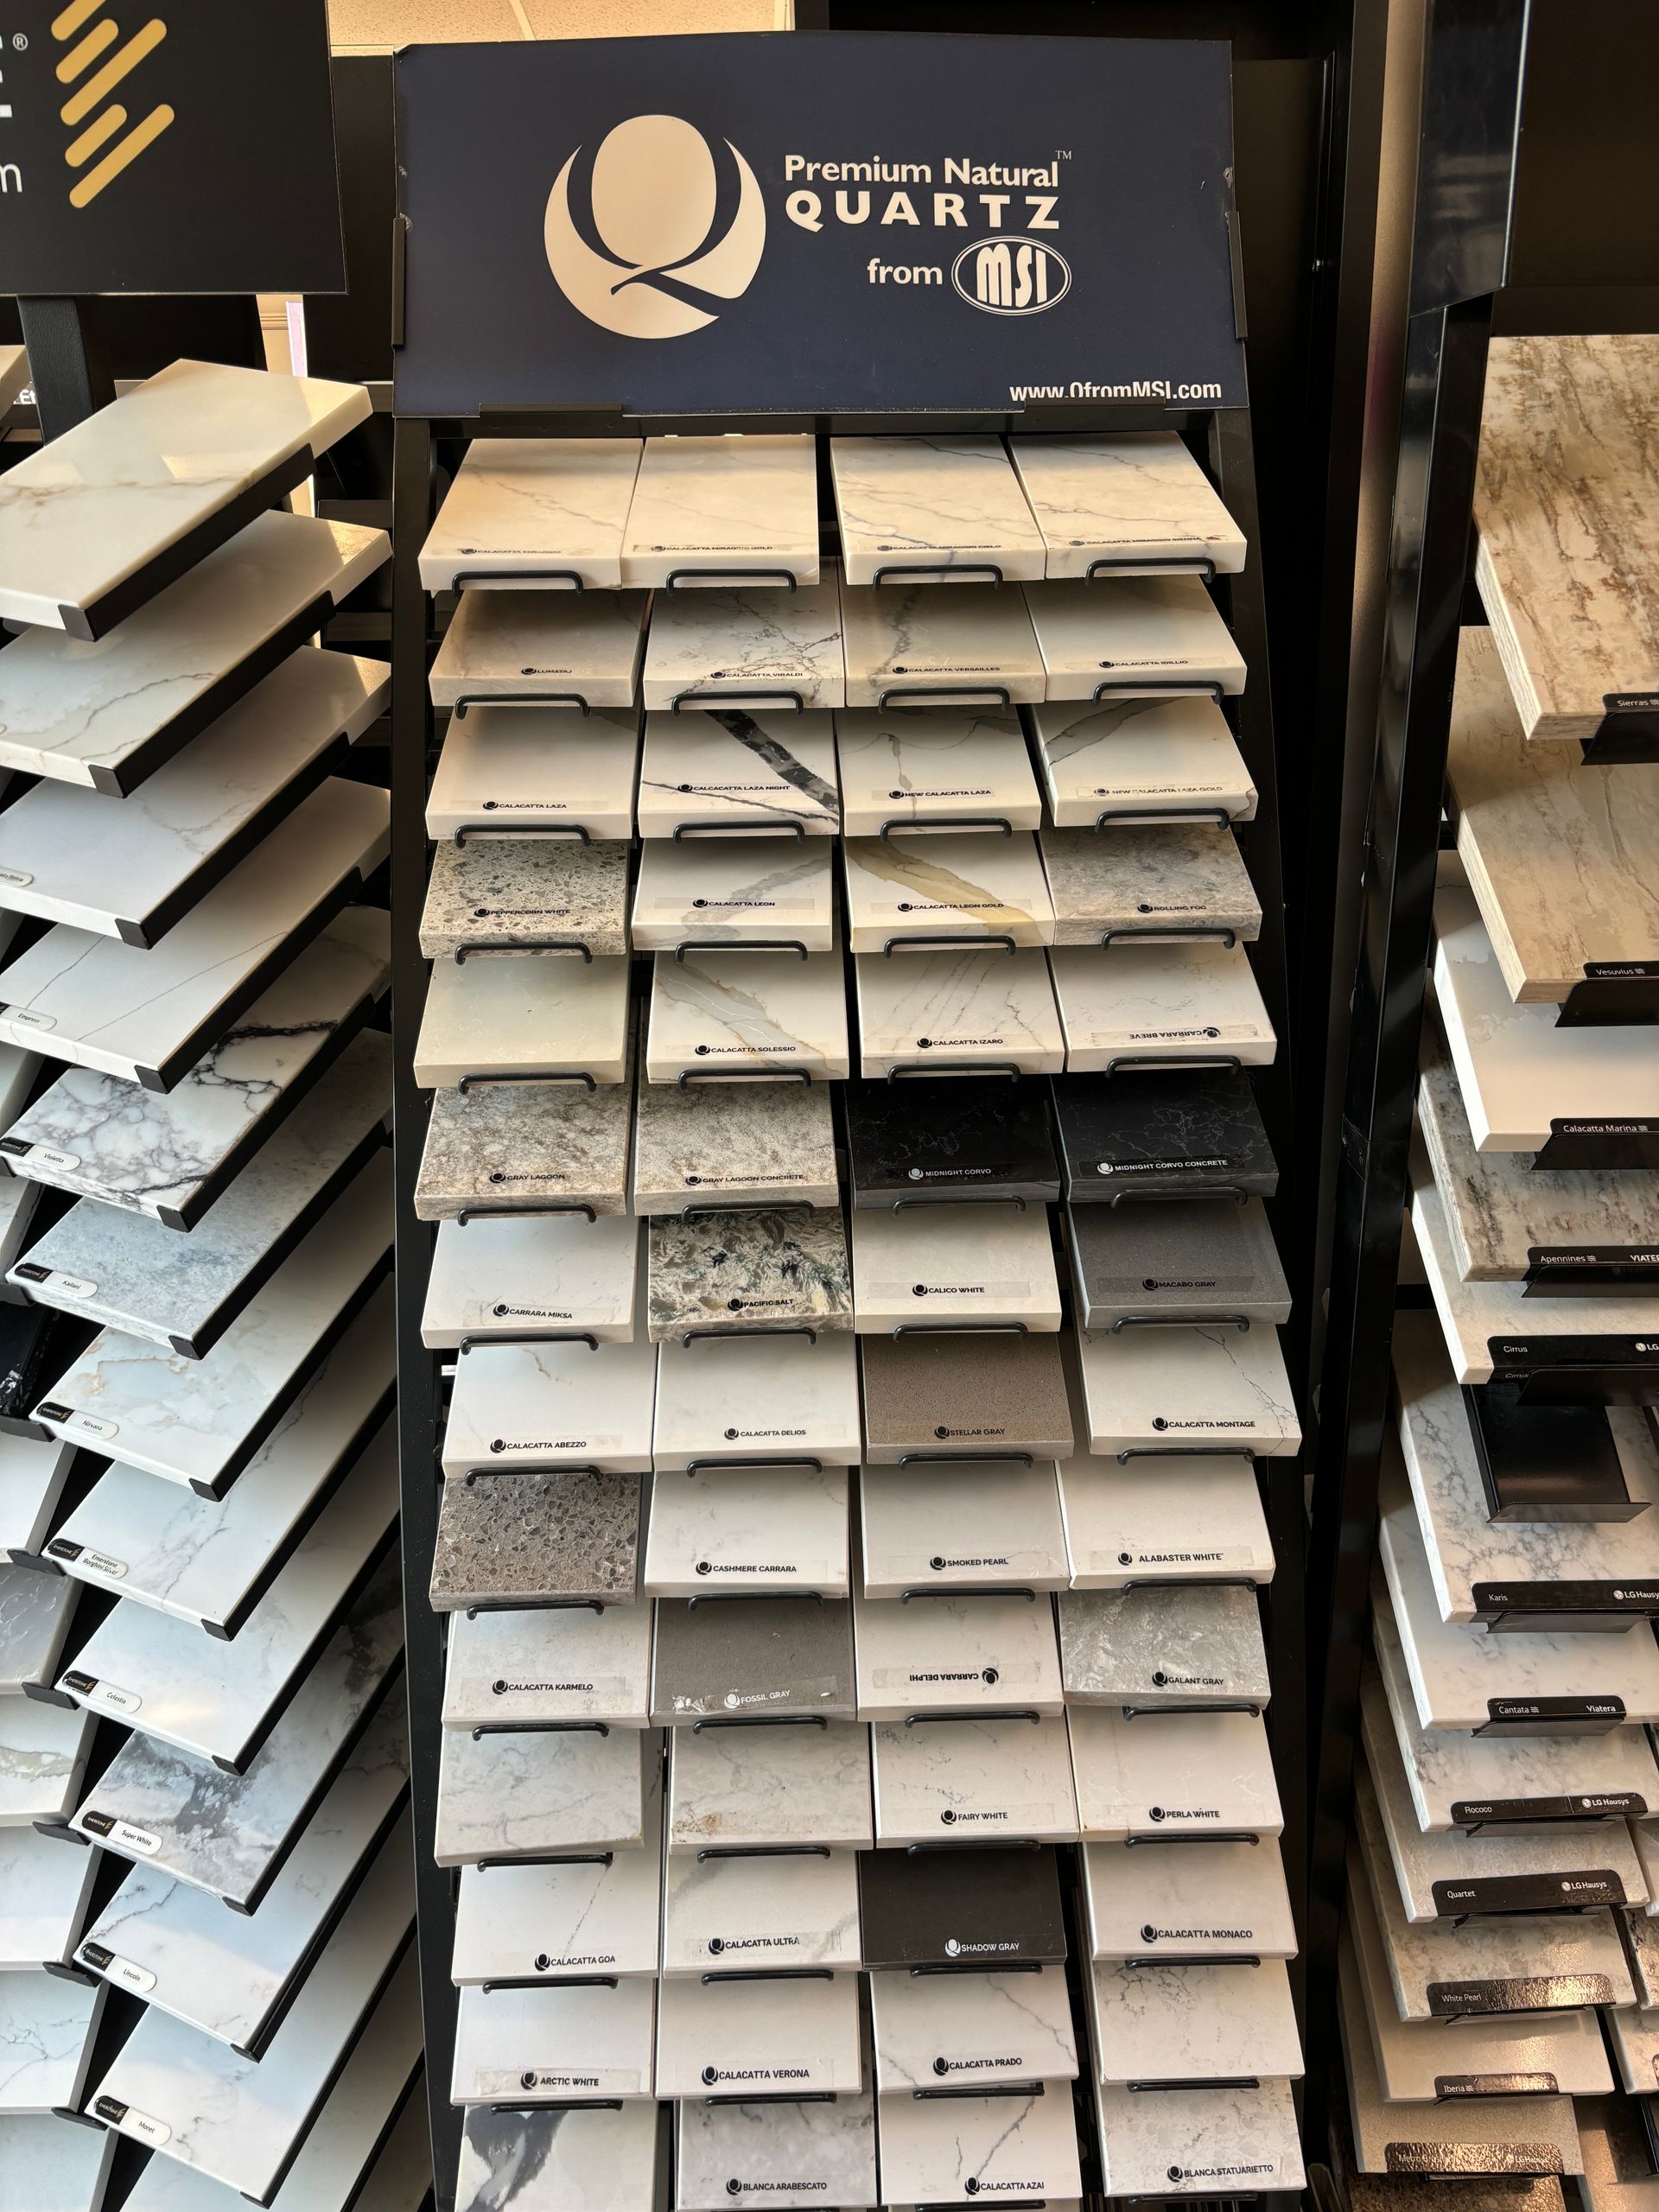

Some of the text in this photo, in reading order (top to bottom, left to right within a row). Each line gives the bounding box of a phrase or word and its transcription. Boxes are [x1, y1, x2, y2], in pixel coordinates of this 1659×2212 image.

[785, 155, 931, 183] Premium
[945, 158, 1058, 188] Natural
[785, 190, 1059, 232] QUARTZ
[868, 244, 1047, 308] from MSI
[43, 1153, 65, 1163] Violetta
[1541, 1255, 1586, 1263] Apennines
[509, 1308, 546, 1318] CARRARA
[82, 1420, 103, 1431] Nirvana
[91, 1554, 118, 1568] Emerstone
[106, 1692, 127, 1704] Celestia
[741, 1690, 790, 1703] FOSSIL GRAY
[1465, 1805, 1492, 1814] Rococo
[1603, 1797, 1629, 1806] Hausys
[121, 1829, 152, 1847] Super White
[1447, 1890, 1476, 1898] Quartet
[1582, 1880, 1606, 1889] Hausys
[726, 1939, 772, 1948] CALACATTA
[551, 1957, 596, 1966] CALACATTA
[123, 1968, 142, 1982] Lincoln
[1441, 1993, 1463, 2002] White
[950, 2057, 1022, 2069] CALACATTA PRADO
[719, 2069, 809, 2080] CALACATTA VERONA
[540, 2077, 599, 2086] ARCTIC WHITE
[138, 2120, 156, 2135] Monet
[1185, 2164, 1273, 2177] BLANCA STATUARIETTO
[776, 2182, 826, 2190] ARABESCATO
[981, 2182, 1025, 2190] CALACATTA
